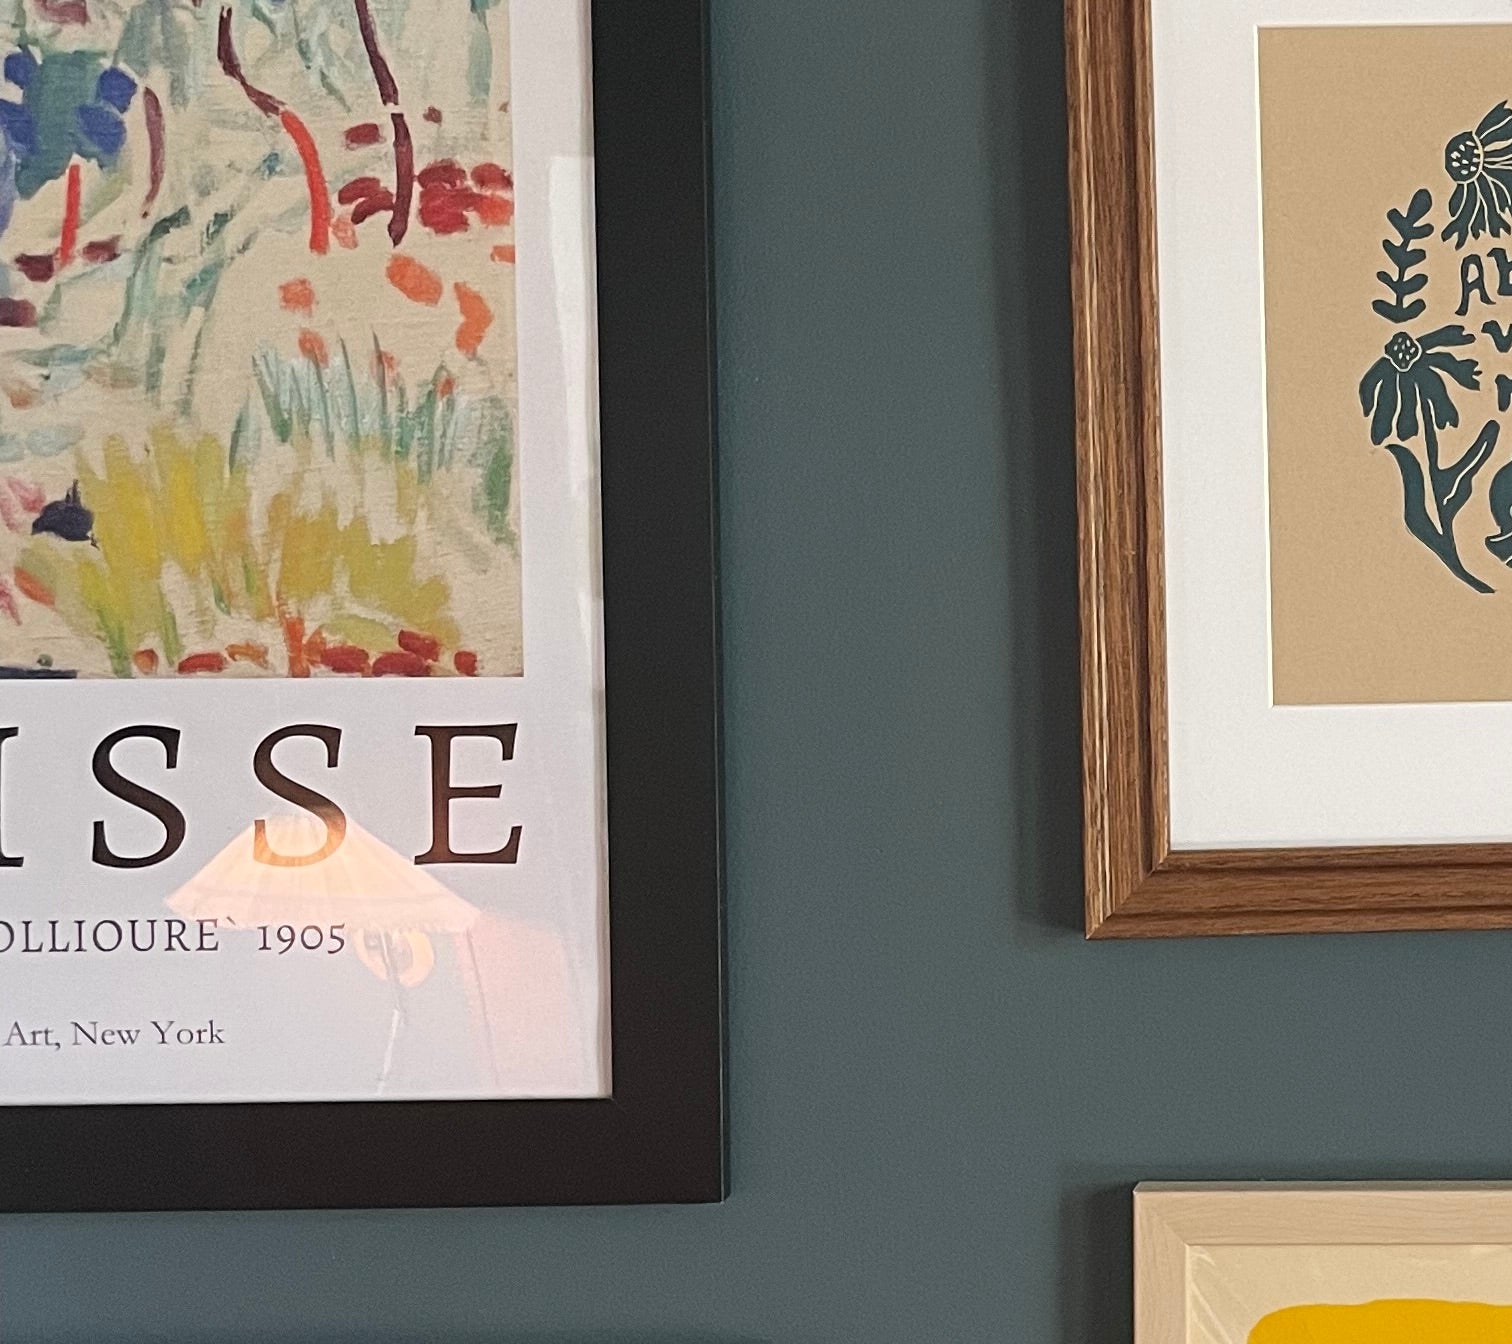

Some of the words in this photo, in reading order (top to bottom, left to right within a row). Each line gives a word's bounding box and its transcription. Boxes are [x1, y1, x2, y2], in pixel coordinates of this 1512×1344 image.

[257, 923, 345, 955] 1905
[3, 1021, 61, 1051] Art,
[71, 1021, 141, 1046] New
[150, 1019, 226, 1045] York
